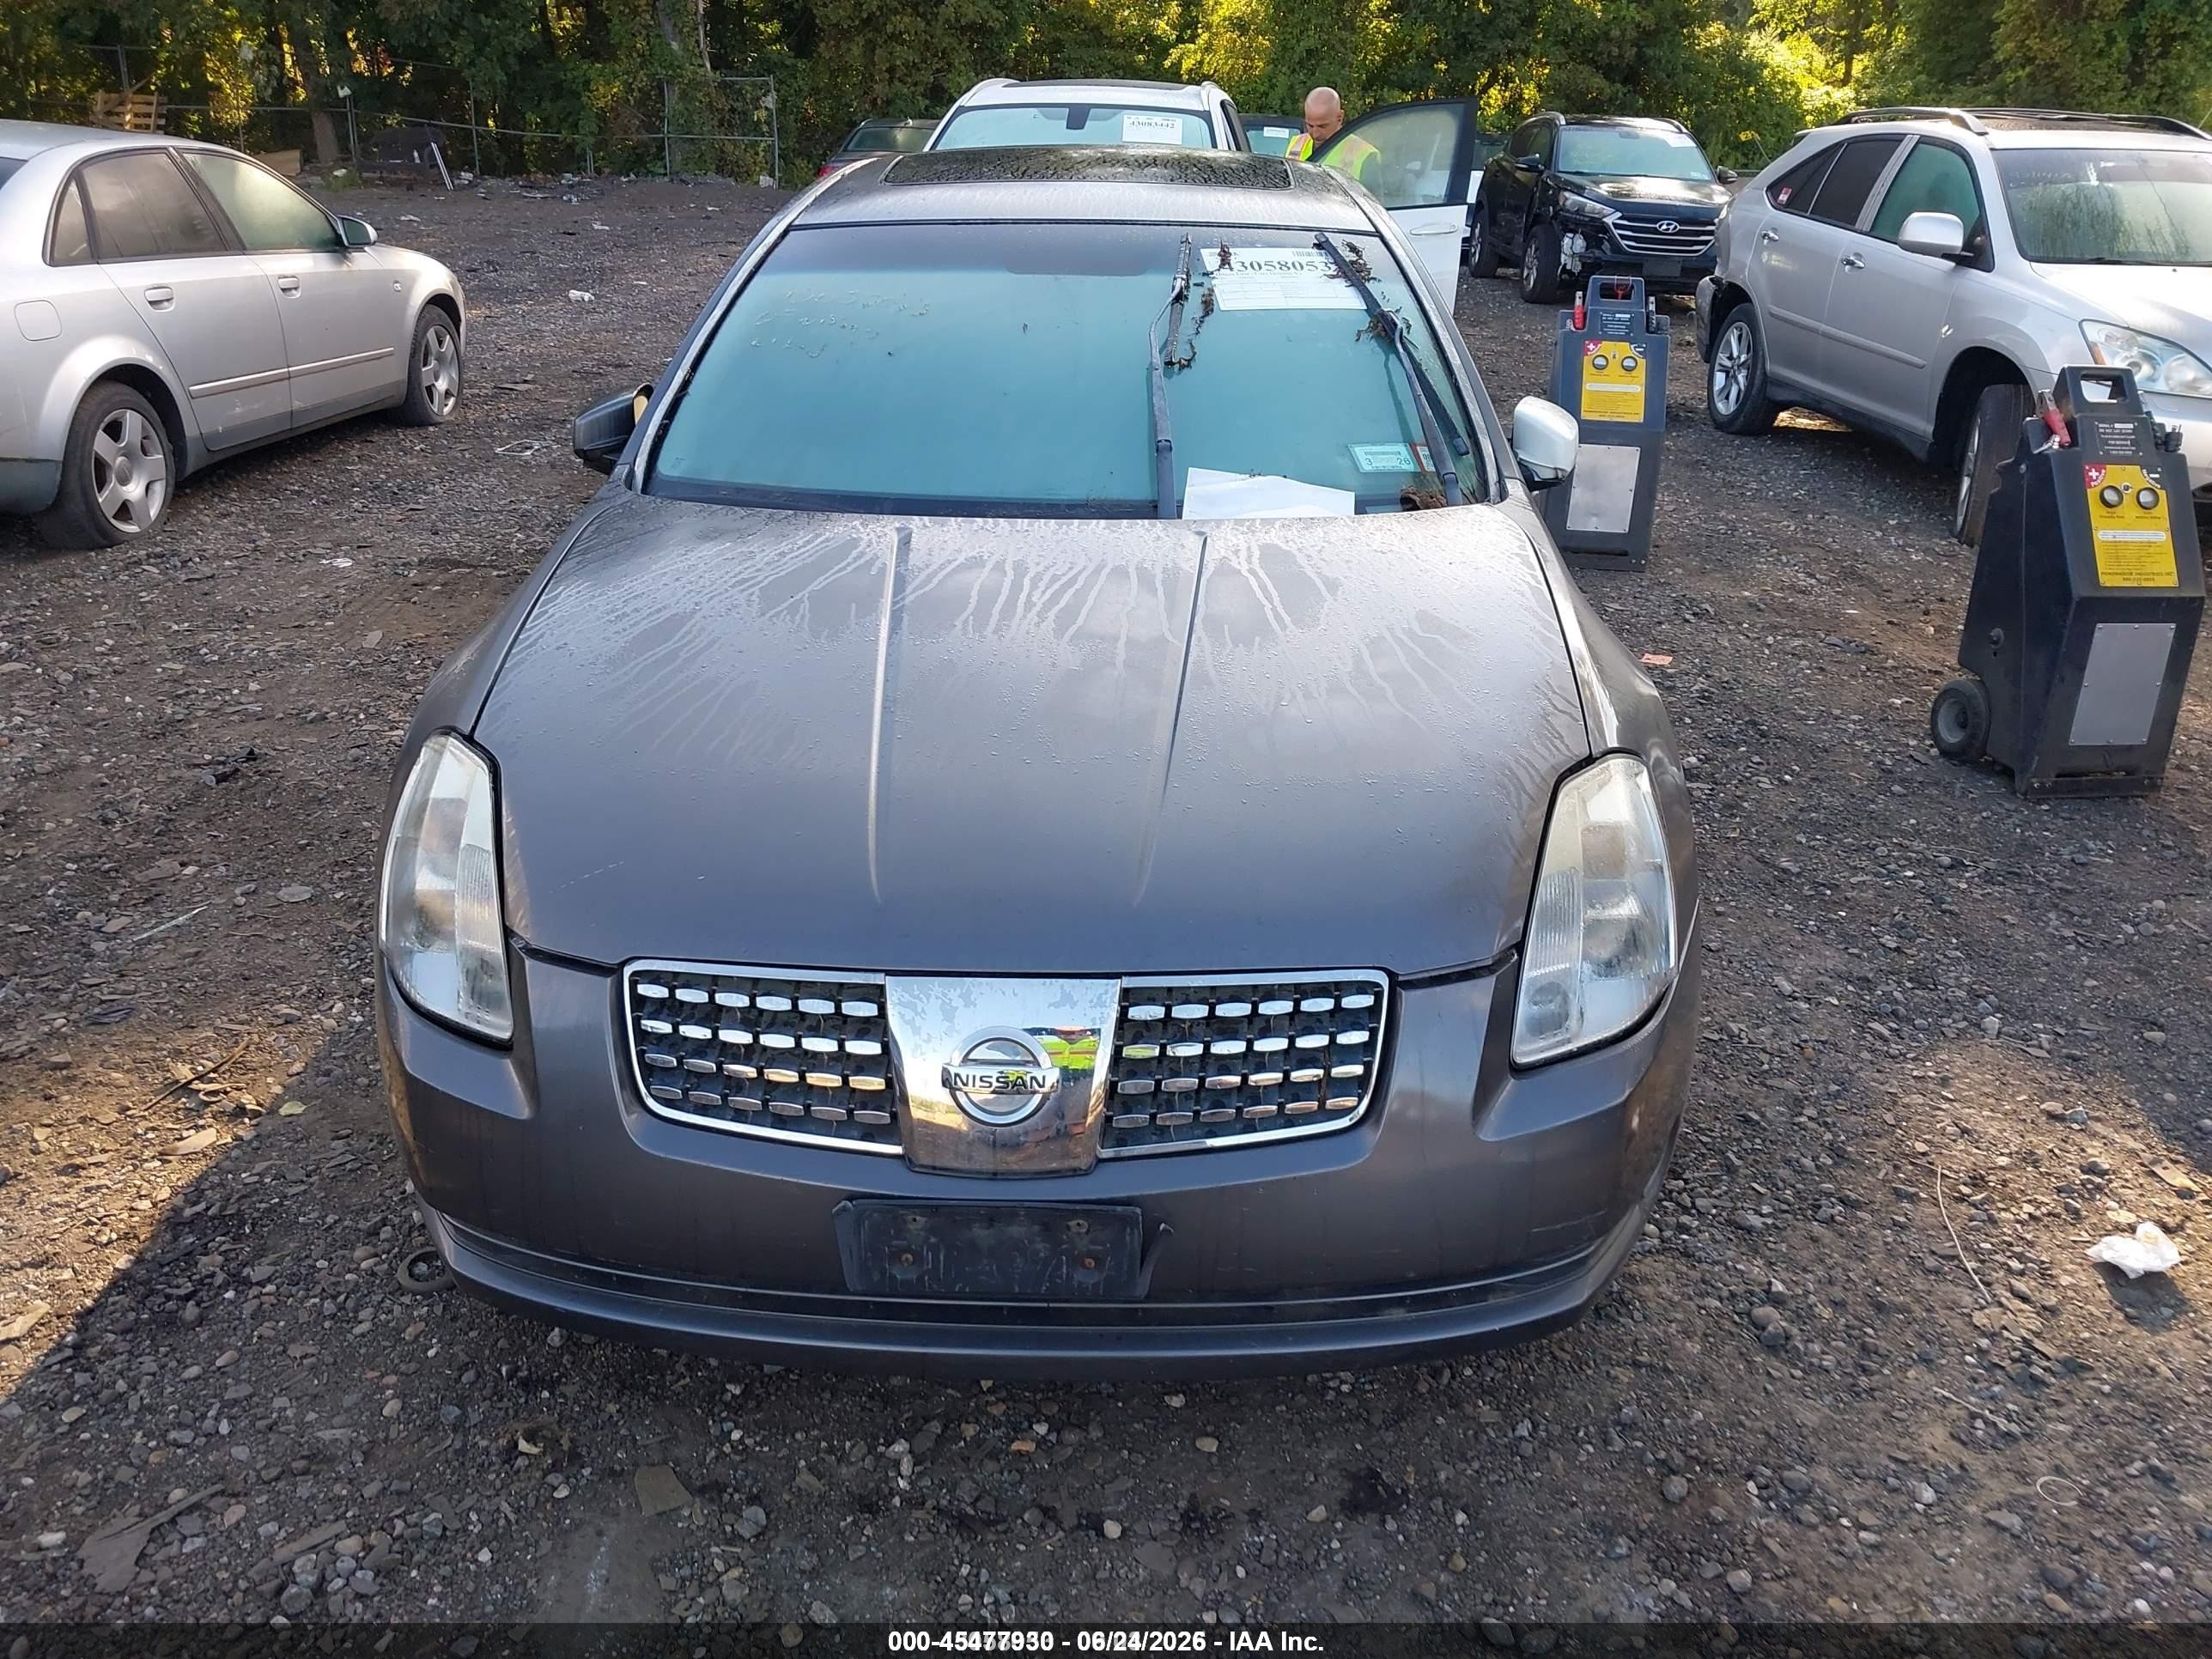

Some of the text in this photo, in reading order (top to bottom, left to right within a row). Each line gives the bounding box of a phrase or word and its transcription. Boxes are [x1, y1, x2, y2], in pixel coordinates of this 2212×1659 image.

[1220, 260, 1331, 272] 3058053
[1364, 458, 1373, 466] 3
[953, 1073, 1046, 1090] NISSAN
